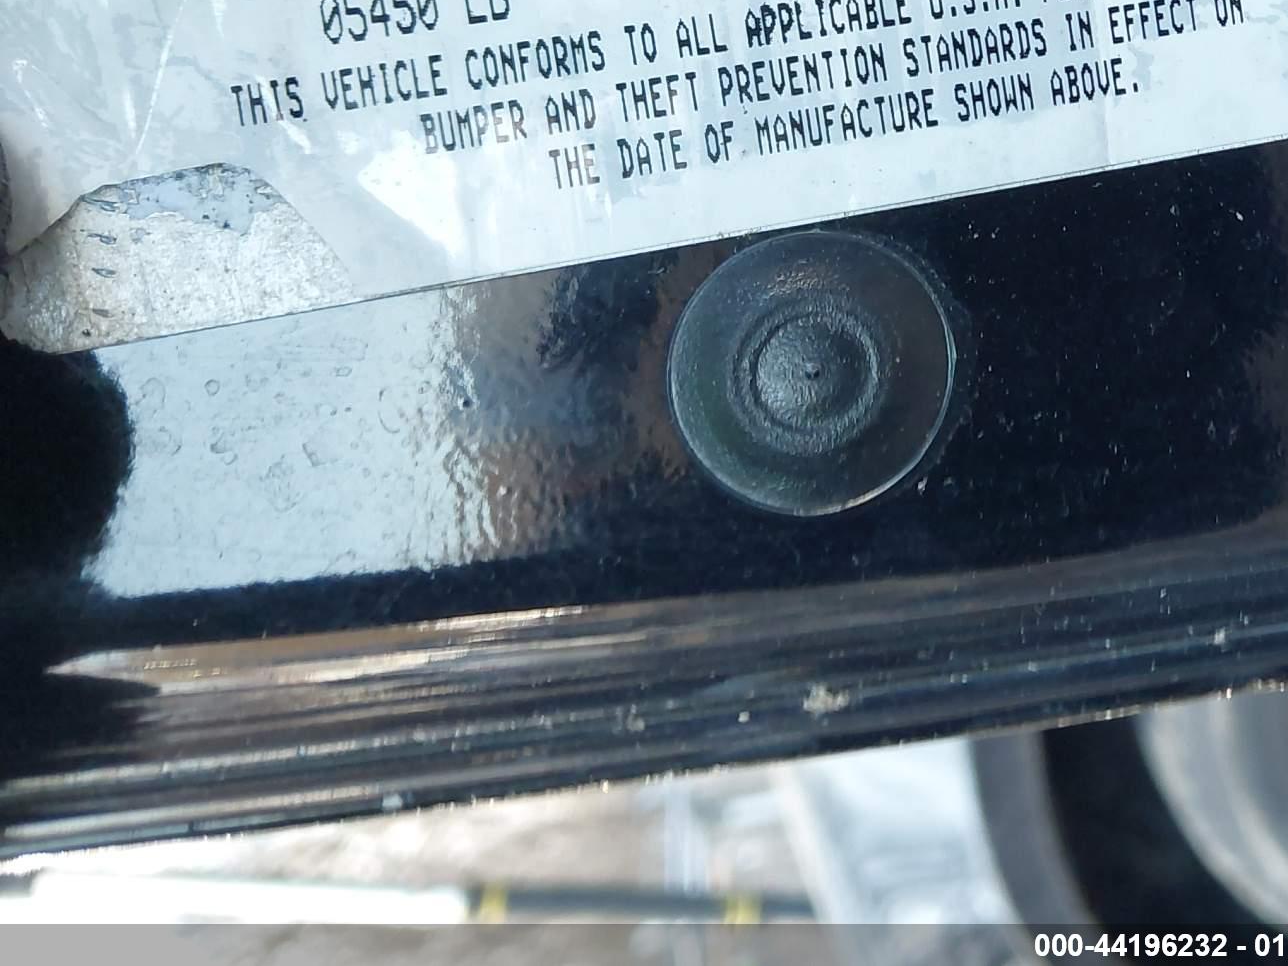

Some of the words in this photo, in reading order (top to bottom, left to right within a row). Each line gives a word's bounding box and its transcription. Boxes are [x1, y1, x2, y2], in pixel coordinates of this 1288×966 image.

[231, 76, 304, 126] THIS
[321, 54, 447, 110] VEHICLE
[466, 30, 605, 89] CONFORMS
[624, 23, 657, 67] TO
[676, 14, 728, 58] ALL
[421, 98, 526, 155] BUMPER
[547, 88, 596, 136] AND
[616, 73, 700, 123] THEFT
[719, 44, 887, 106] PREVENTION
[904, 20, 1047, 77] STANDARDS
[1066, 11, 1094, 50] IN
[549, 144, 600, 189] THE
[617, 130, 688, 178] DATE
[705, 120, 734, 164] OF
[756, 88, 938, 156] MANUFACTURE
[955, 70, 1034, 123] SHOWN
[1051, 59, 1139, 105] ABOVE.
